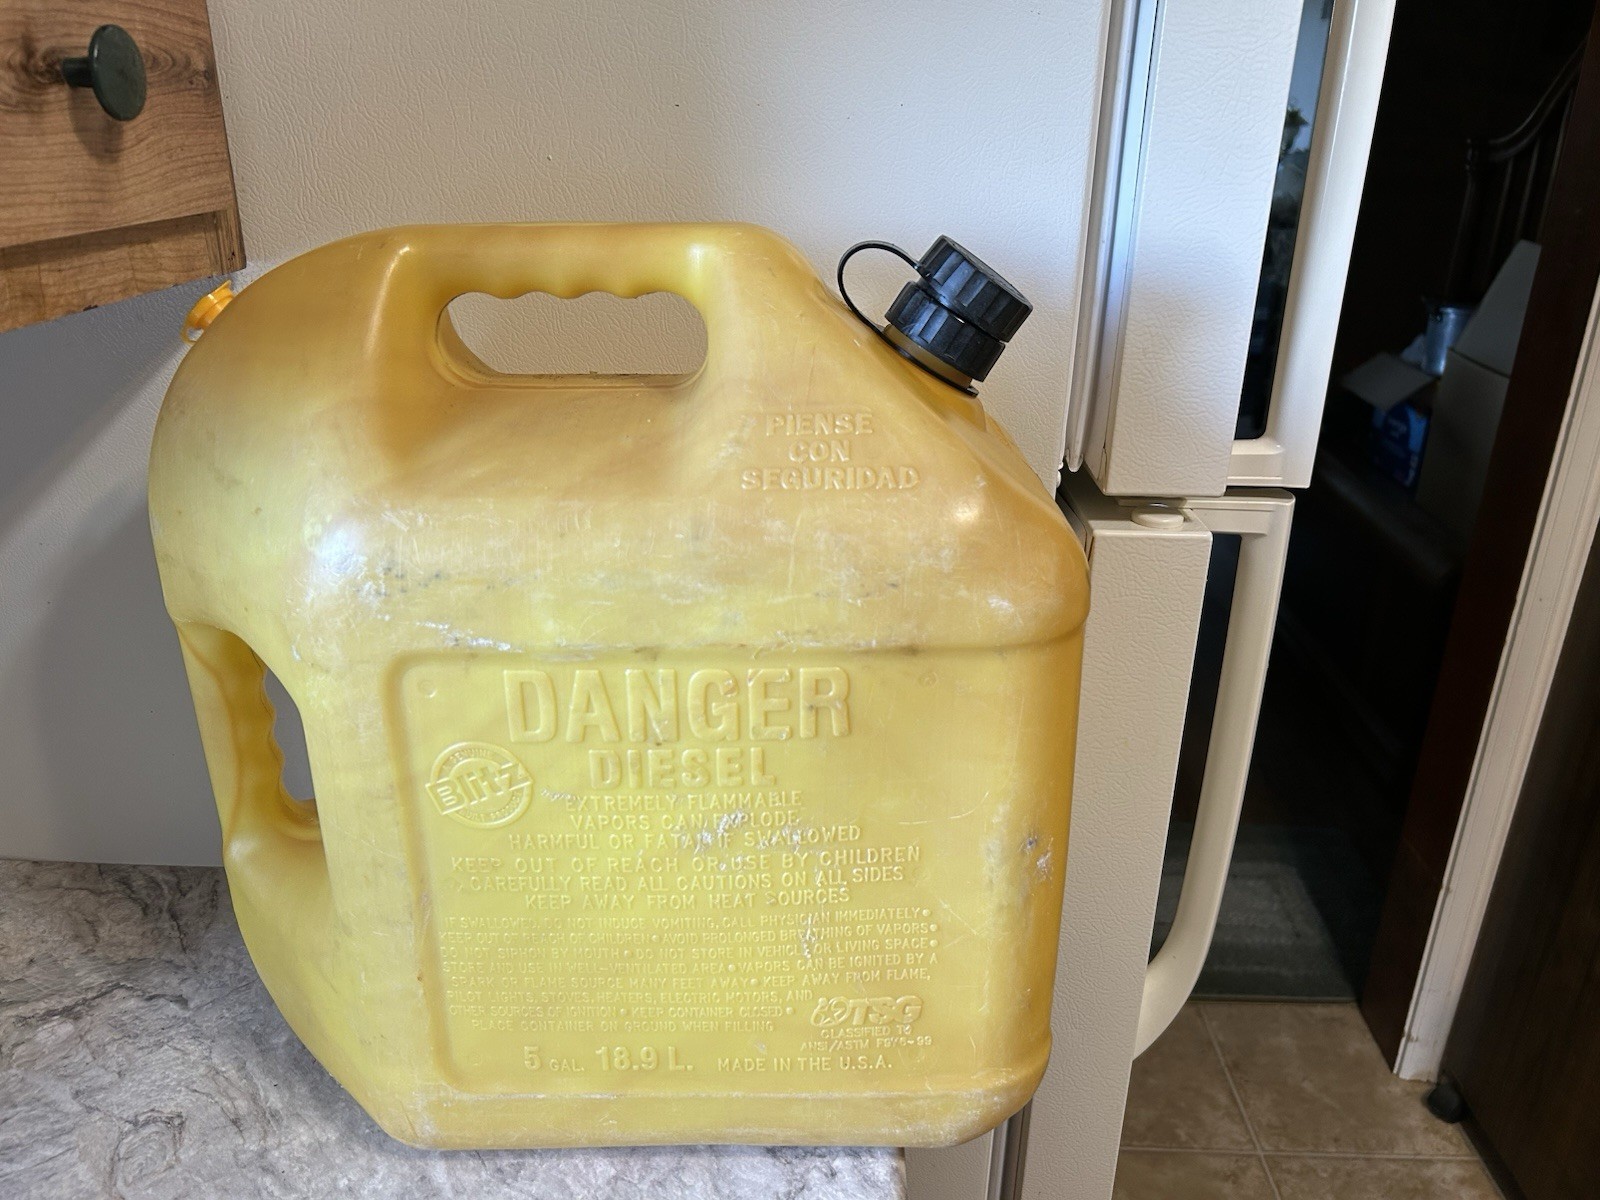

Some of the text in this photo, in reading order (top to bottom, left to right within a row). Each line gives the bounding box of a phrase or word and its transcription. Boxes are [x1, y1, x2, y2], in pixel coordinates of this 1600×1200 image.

[766, 413, 873, 436] PIENSE
[788, 440, 849, 462] CON
[741, 466, 921, 490] SEGURIDAD
[502, 666, 851, 743] DANGER
[588, 746, 777, 789] DIESEL
[566, 791, 802, 811] EXTREMELY FLAMMABLE
[570, 815, 650, 831] VAPORS
[662, 813, 703, 830] CAN
[509, 834, 599, 849] HARMFUL
[608, 834, 634, 849] OR
[719, 832, 733, 848] IF
[745, 825, 861, 847] SWALLOWED
[450, 846, 921, 873] KEEP OUT OF REACH OR USE BY CHILDREN
[470, 866, 903, 892] CAREFULLY READ ALL CAUTIONS ON ALL SIDES
[525, 888, 850, 910] KEEP AWAY FROM HEAT SOURCES
[567, 917, 591, 929] NOT
[599, 917, 646, 929] INDUCE
[722, 916, 758, 929] CALL
[760, 911, 830, 927] PHYSICIAN
[835, 907, 920, 922] IMMEDIATELY
[439, 933, 472, 944] KEEP
[477, 933, 498, 944] OUT
[570, 933, 584, 944] OF
[588, 933, 650, 944] CHILDREN
[662, 933, 698, 945] AVOID
[702, 931, 776, 944] PROLONGED
[780, 926, 852, 942] BREATHING
[856, 924, 873, 937] OF
[876, 922, 928, 935] VAPORS
[465, 947, 491, 959] NOT
[498, 948, 546, 959] SIPHON
[552, 948, 568, 959] BY
[576, 947, 619, 959] MOUTH
[636, 948, 654, 959] DO
[659, 948, 684, 960] NOT
[692, 947, 734, 959] STORE
[739, 947, 752, 959] IN
[814, 942, 831, 954] OR
[838, 939, 879, 953] LIVING
[885, 937, 928, 950] SPACE
[519, 962, 544, 974] USE
[692, 961, 729, 973] AREA
[739, 959, 790, 972] VAPORS
[797, 956, 823, 970] CAN
[828, 956, 845, 969] BE
[850, 952, 900, 967] IGNITED
[906, 952, 923, 965] BY
[930, 953, 938, 965] A
[450, 976, 494, 988] SPARK
[571, 977, 623, 988] SOURCE
[629, 977, 667, 988] MANY
[672, 977, 703, 989] FEET
[711, 976, 751, 989] AWAY
[763, 975, 795, 988] KEEP
[802, 973, 839, 986] AWAY
[846, 970, 880, 984] FROM
[886, 968, 931, 981] FLAME,
[599, 991, 657, 1005] HEATERS,
[660, 990, 720, 1003] ELECTRIC
[725, 990, 783, 1003] MOTORS,
[785, 989, 812, 1001] AND
[491, 1006, 543, 1018] SOURCES
[548, 1006, 562, 1017] OF
[631, 1007, 664, 1018] KEEP
[668, 1007, 733, 1019] CONTAINER
[739, 1006, 783, 1018] CLOSED
[472, 1019, 774, 1033] PLACE CONTAINER ON GROUND WHEN FILLING
[821, 1024, 912, 1039] CLASSIFIED TO
[800, 1039, 869, 1052] ANSI/ASTM
[523, 1045, 893, 1072] 5 GAL. 18.9 L. MADE IN THE U.S.A.
